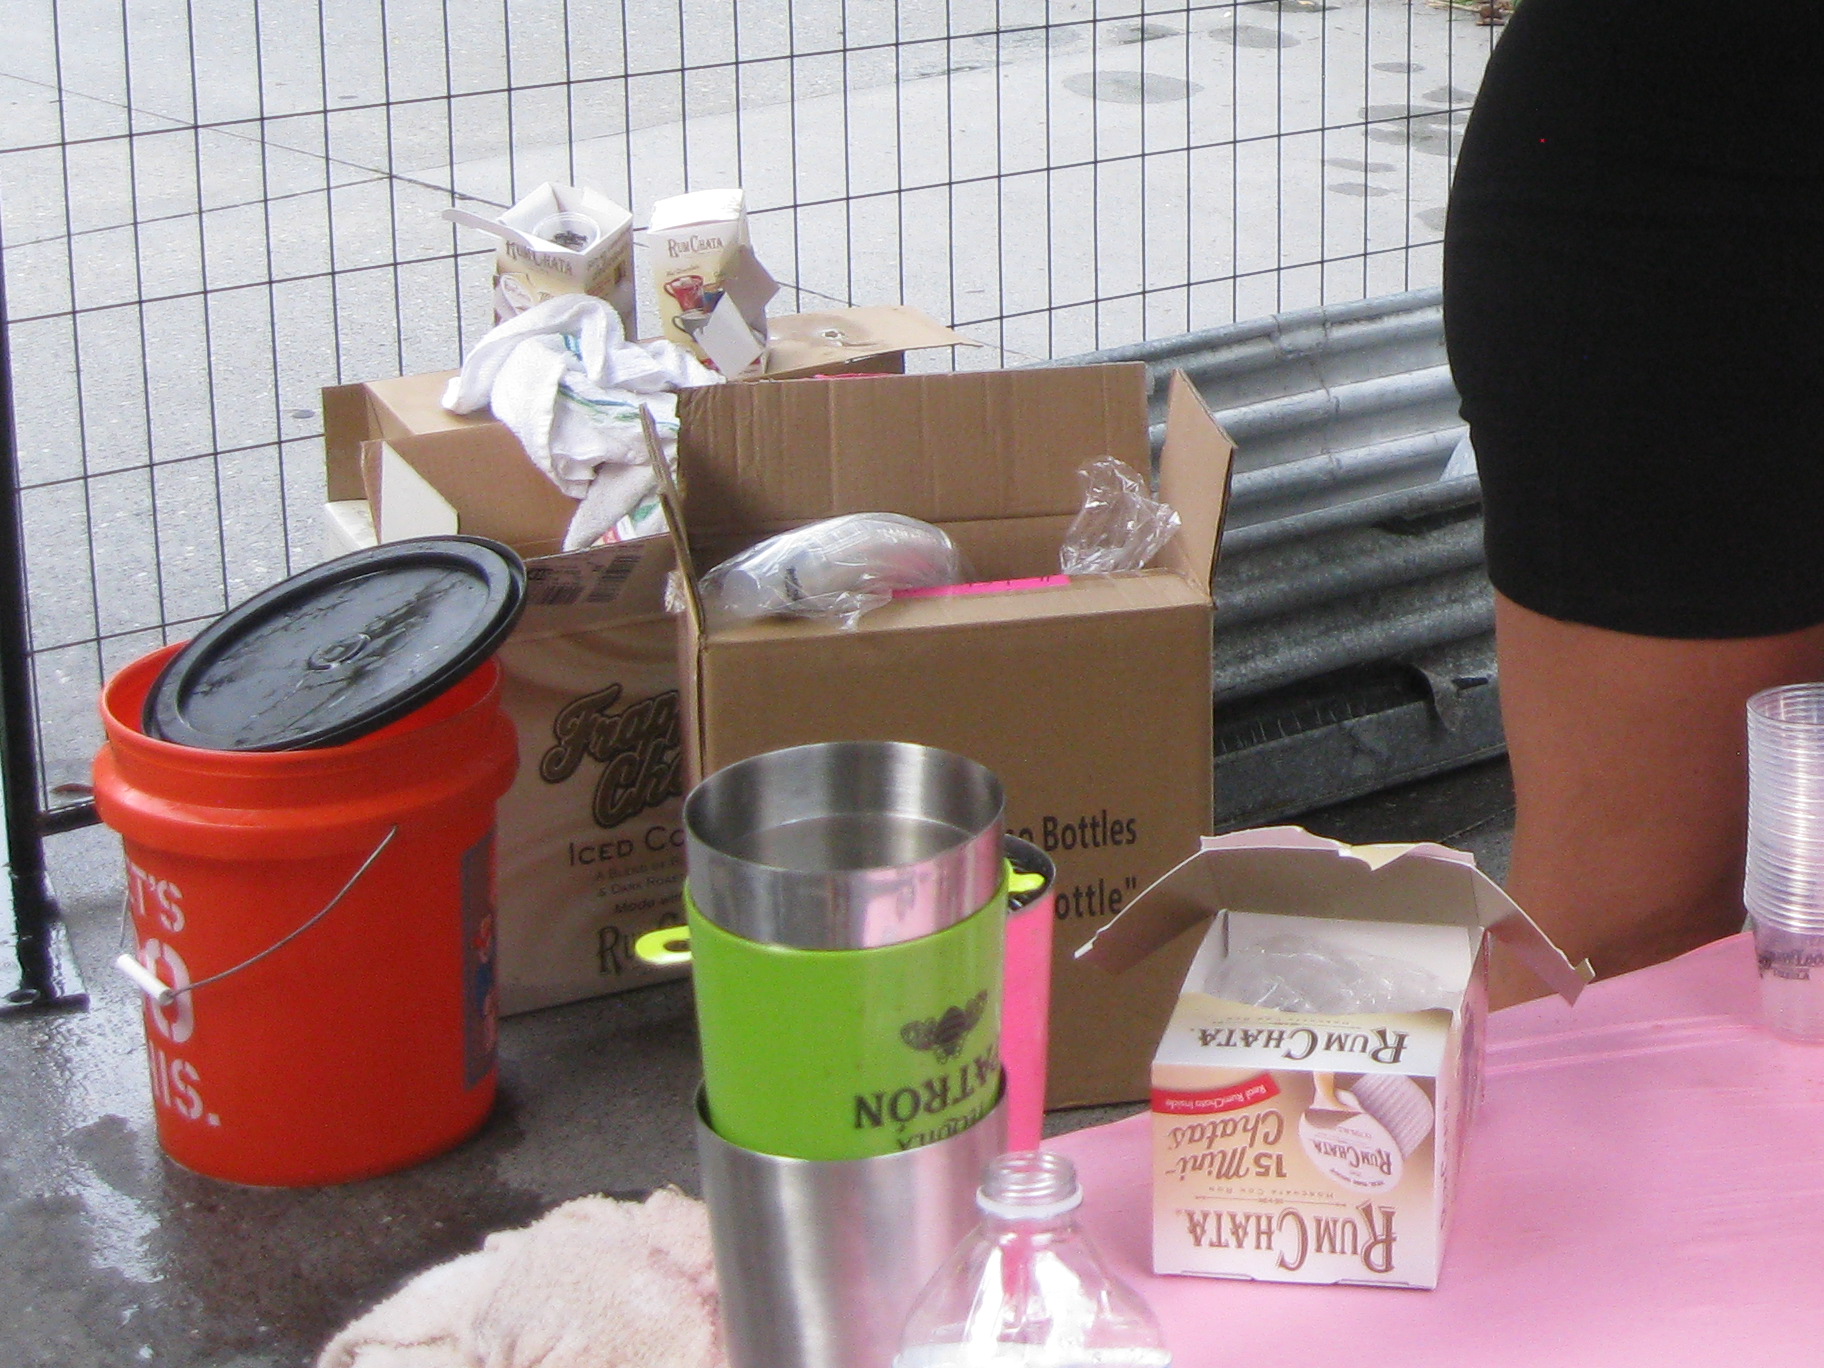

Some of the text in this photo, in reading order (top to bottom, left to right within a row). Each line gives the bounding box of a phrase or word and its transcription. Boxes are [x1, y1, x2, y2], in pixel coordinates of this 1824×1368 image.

[1043, 809, 1137, 851] Bottles
[568, 839, 634, 866] ICED
[141, 937, 194, 1043] O
[1199, 1027, 1410, 1064] RUMCHATA
[1246, 1084, 1267, 1100] Real
[1168, 1110, 1284, 1148] Chatas
[1253, 1152, 1287, 1178] 15
[1184, 1199, 1398, 1273] RUMCHATA
